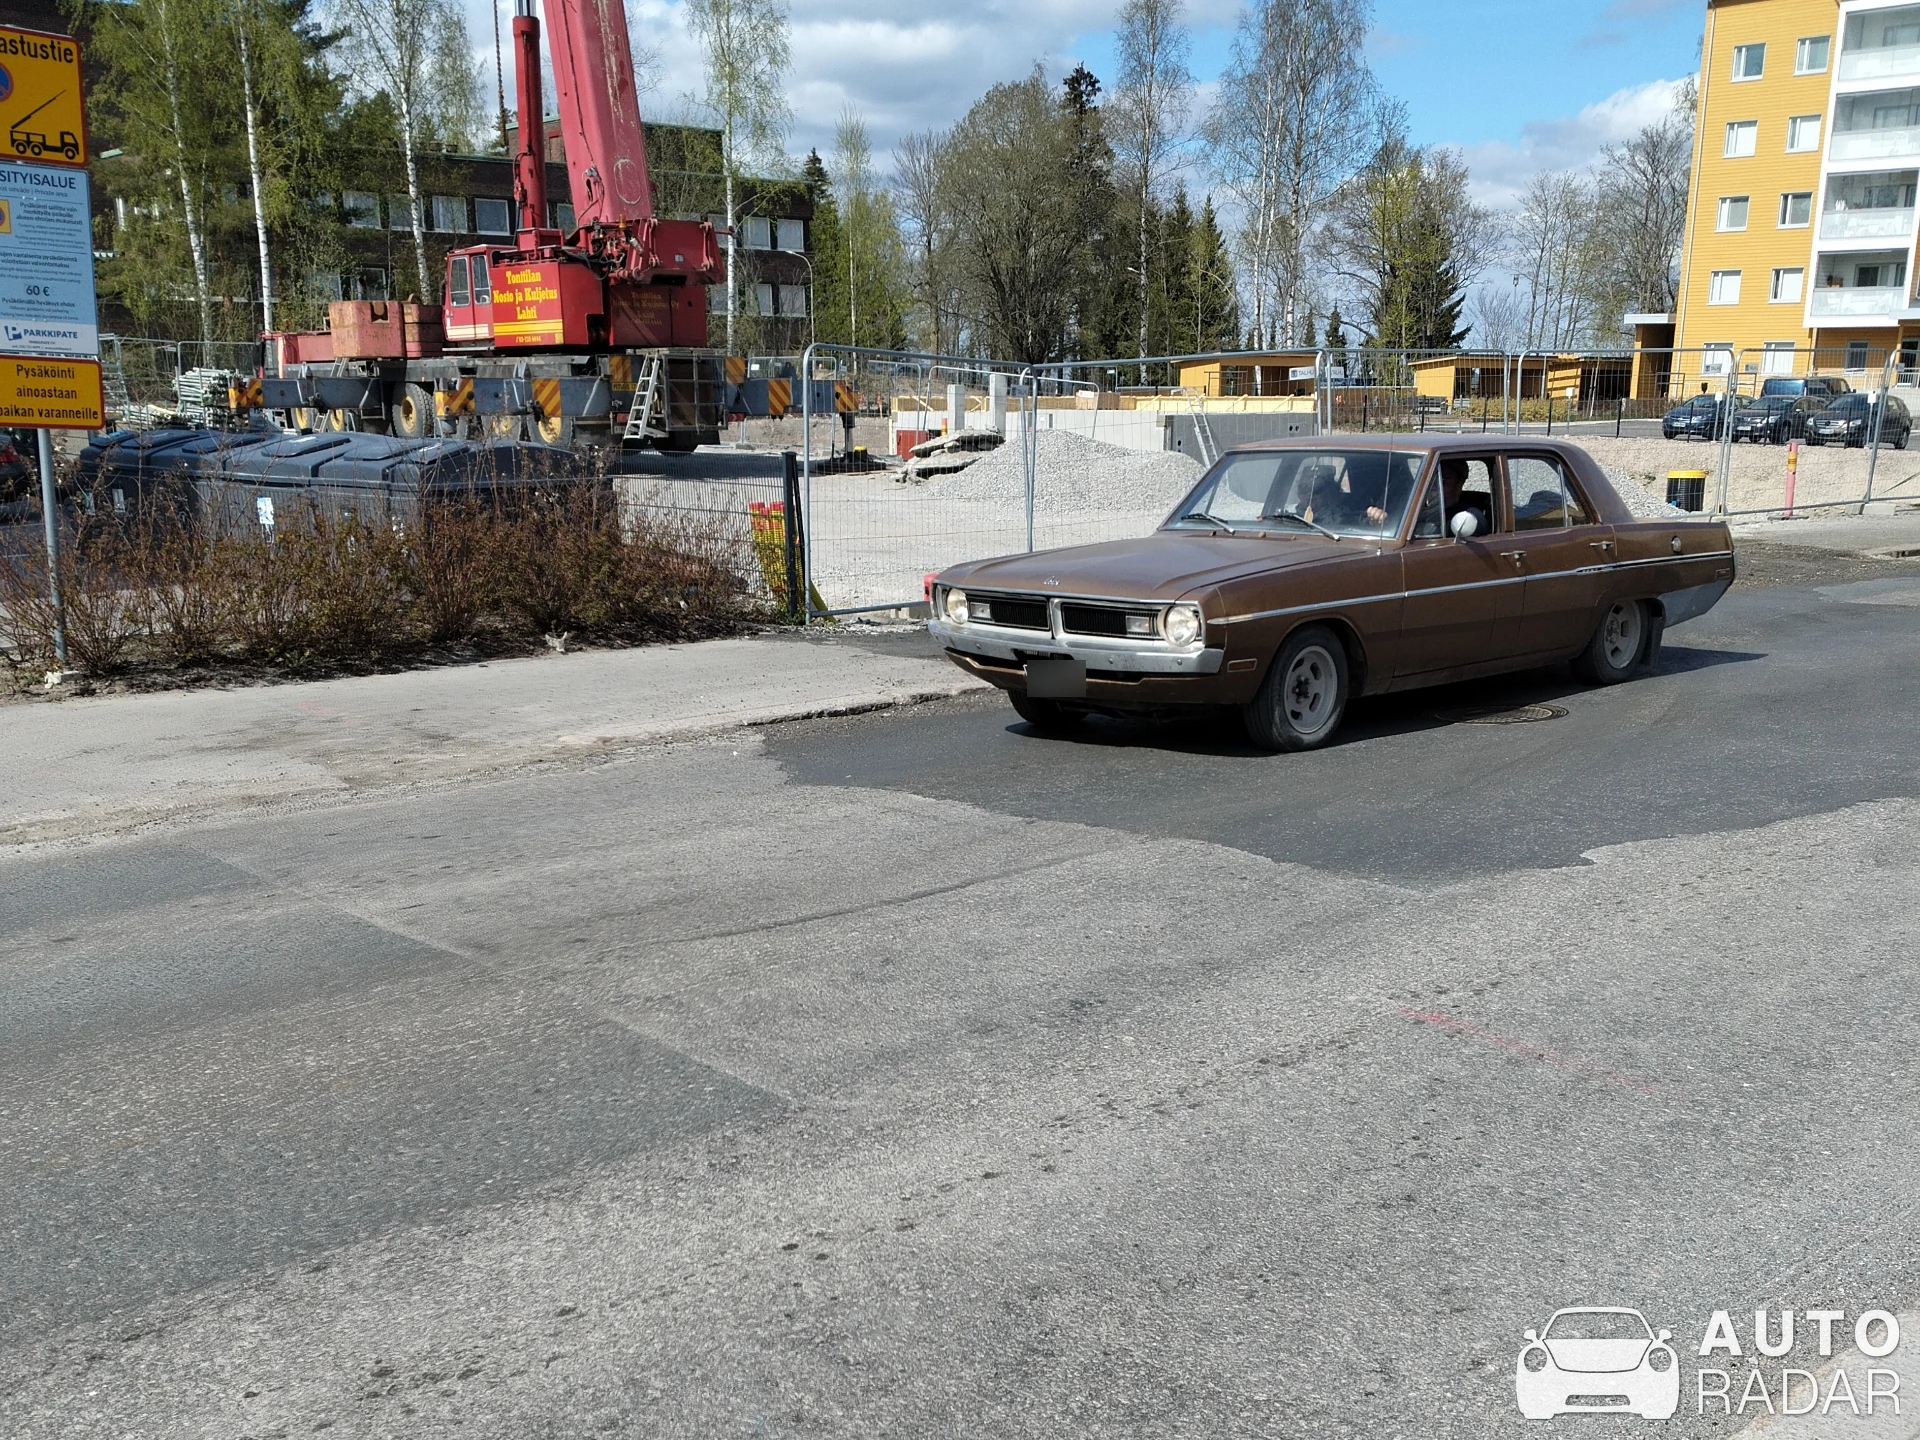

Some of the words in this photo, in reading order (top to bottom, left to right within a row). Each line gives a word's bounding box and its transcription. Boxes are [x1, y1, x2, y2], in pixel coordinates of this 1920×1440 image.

[0, 35, 73, 63] astustie
[0, 170, 76, 189] SITYISALUE
[35, 188, 54, 197] Private
[506, 269, 541, 284] Tonttilan
[26, 285, 40, 296] 60
[43, 286, 50, 296] €
[493, 290, 514, 303] Nosto
[516, 289, 523, 305] ja
[524, 287, 557, 303] Kuljetus
[516, 305, 537, 319] Lahti
[24, 329, 77, 339] PARKKIPATE
[16, 364, 75, 379] Pysäköinti
[16, 385, 77, 399] ainoastaan
[38, 407, 98, 420] varanneille
